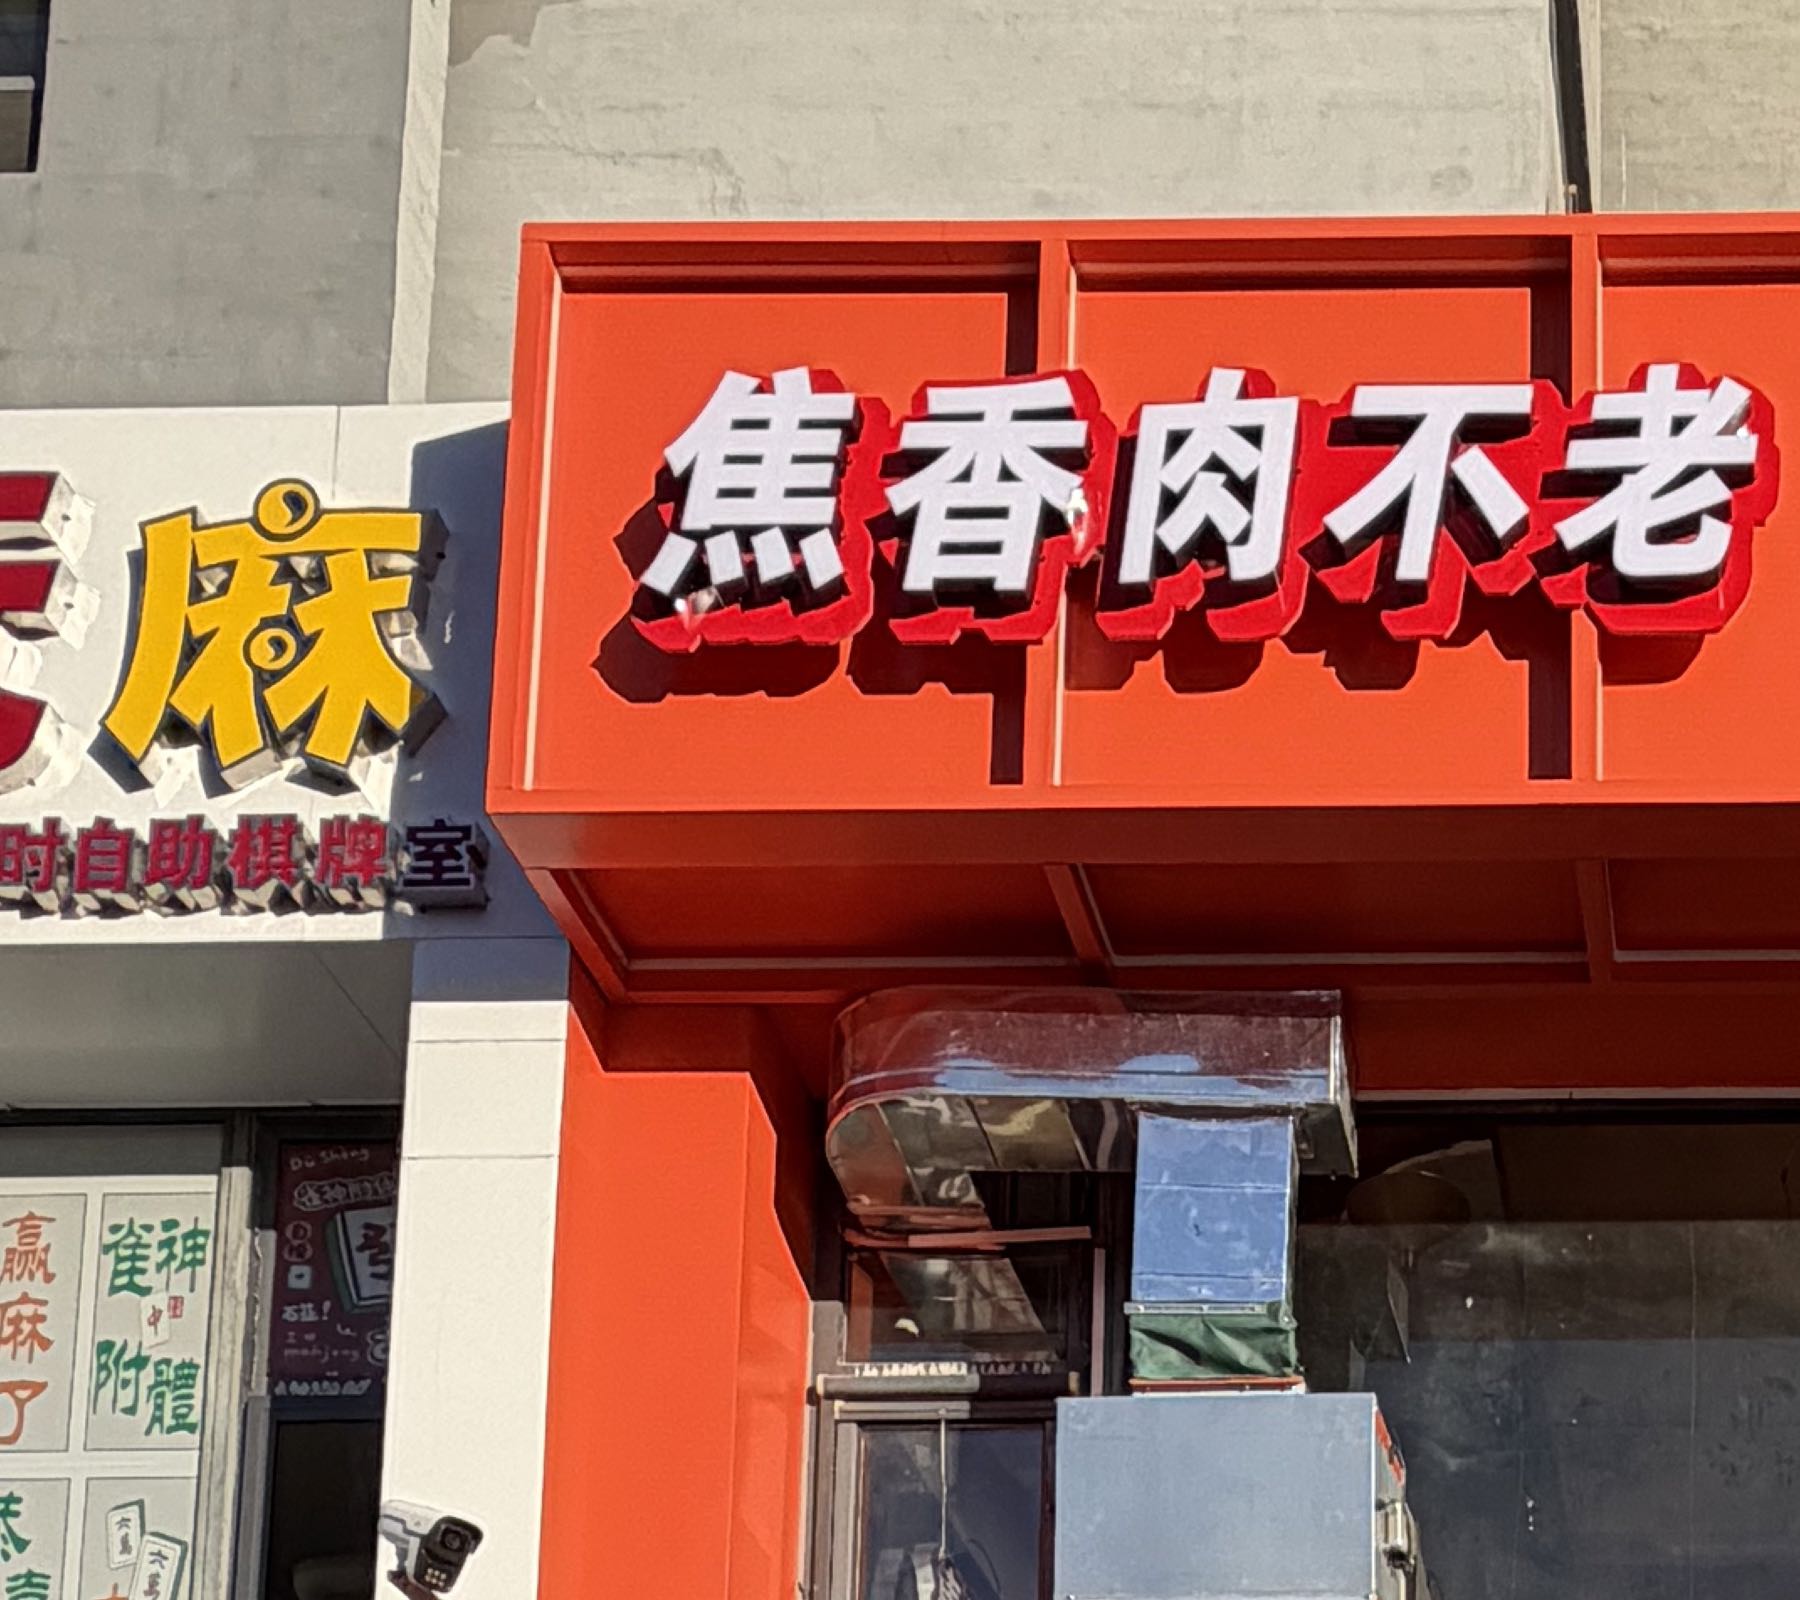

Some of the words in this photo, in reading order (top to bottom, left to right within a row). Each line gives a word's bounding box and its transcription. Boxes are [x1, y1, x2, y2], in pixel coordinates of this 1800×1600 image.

[642, 363, 1756, 594] 焦香肉不老
[0, 815, 474, 892] 时自助棋牌室
